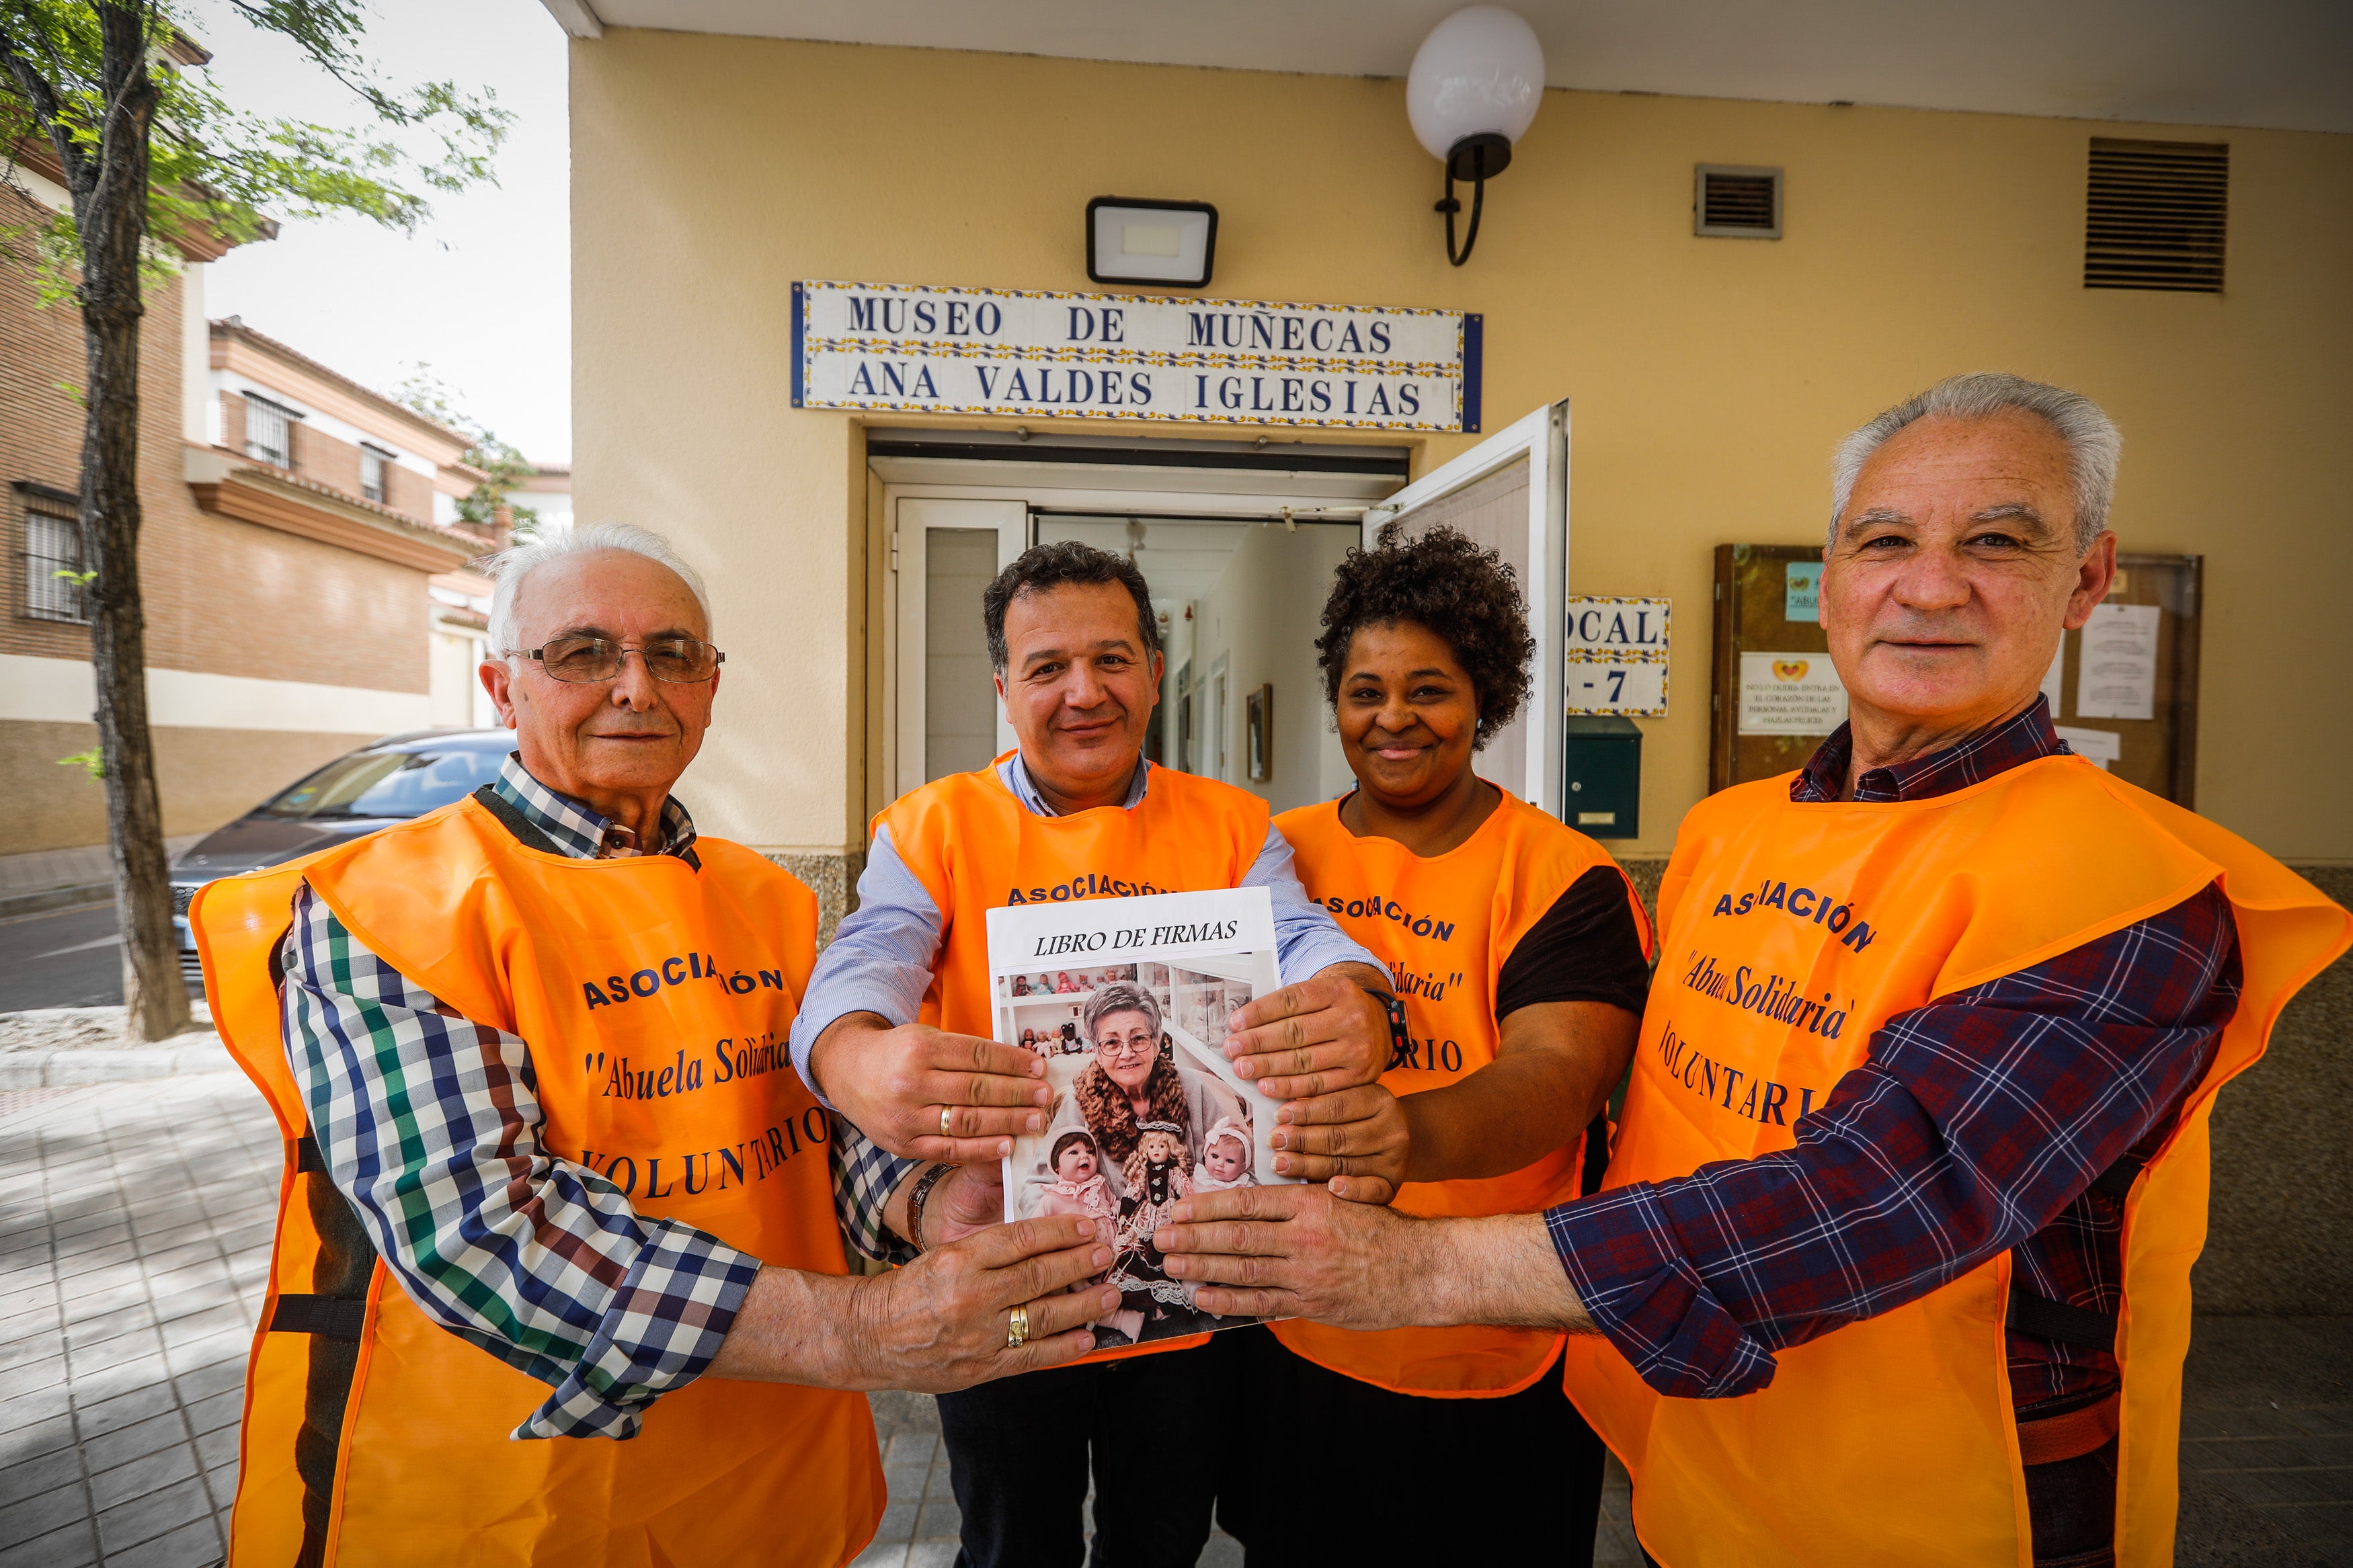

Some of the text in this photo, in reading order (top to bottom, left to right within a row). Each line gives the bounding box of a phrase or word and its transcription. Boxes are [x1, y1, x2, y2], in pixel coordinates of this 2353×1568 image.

[847, 296, 1392, 354] MUSEO DE MUÑECAS
[847, 361, 1421, 415] ANA VALDES IGLESIAS
[1568, 610, 1658, 643] CAL
[1033, 919, 1238, 956] LIBRO DE FIRMAS
[1712, 880, 1877, 953] ASIACIÓN
[583, 952, 783, 1009] ASOCIAIÓN
